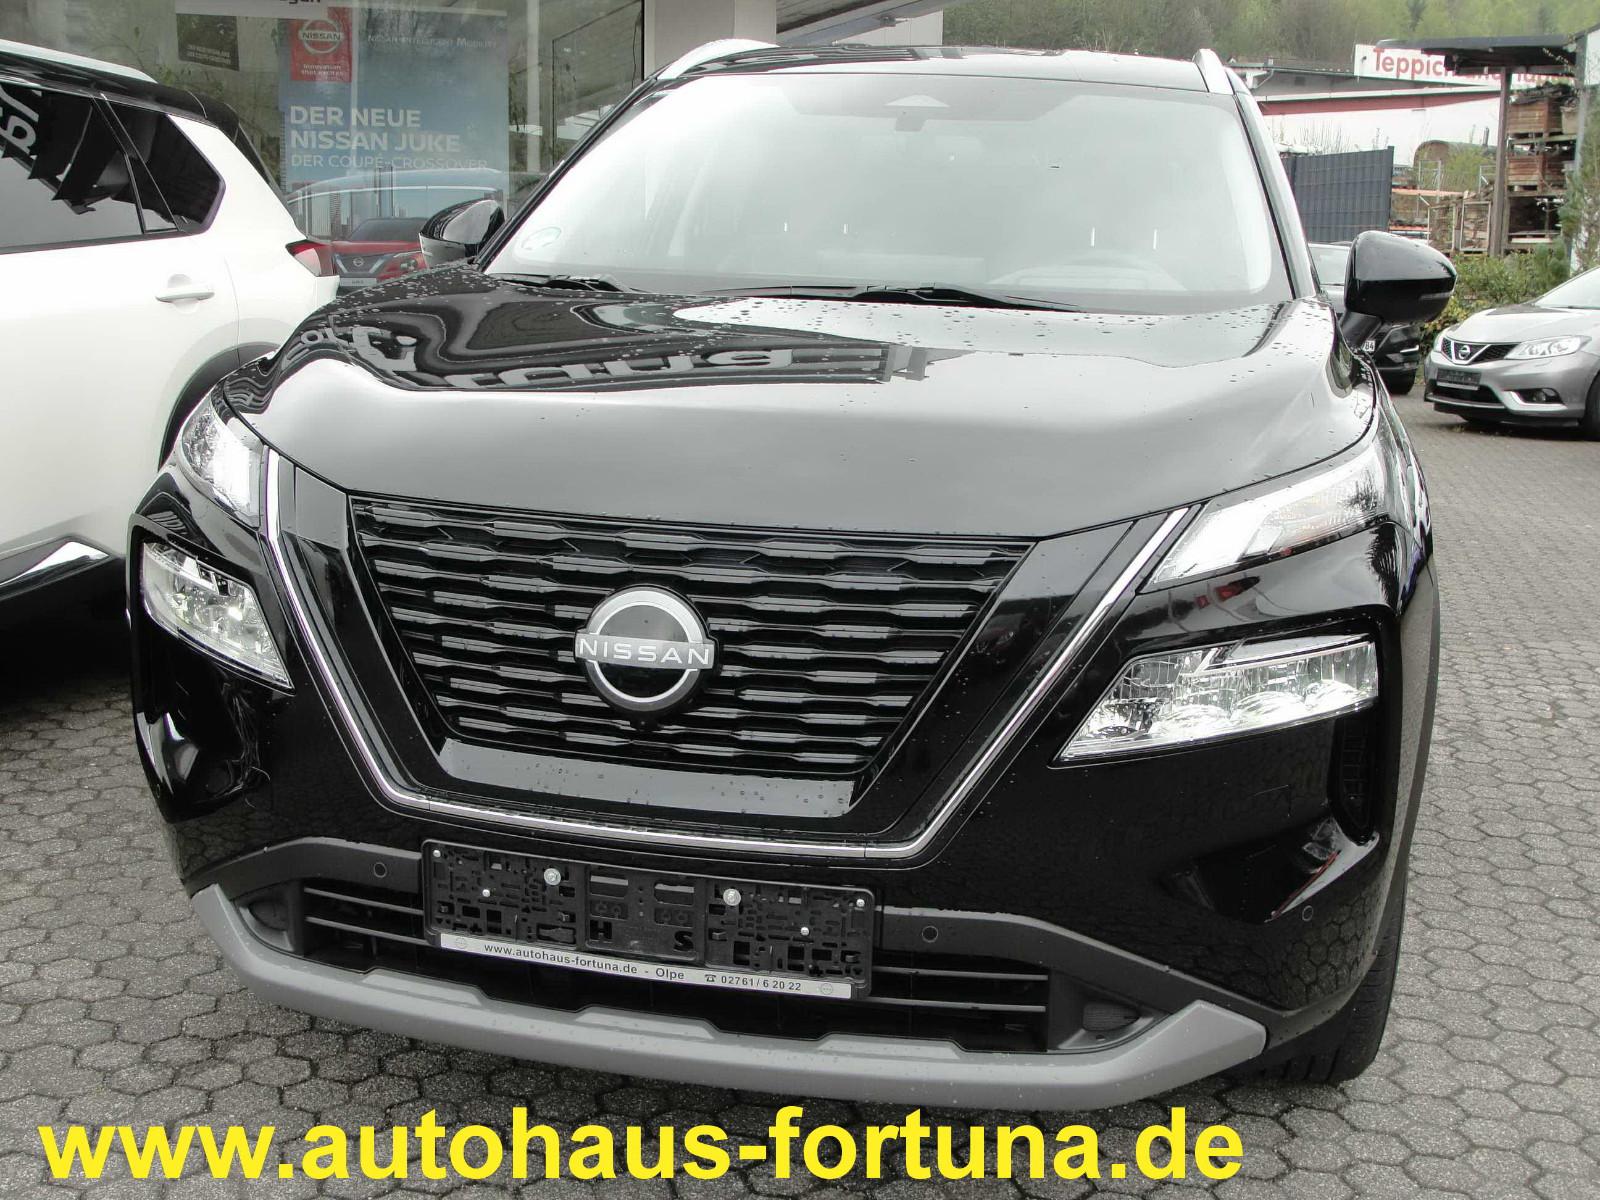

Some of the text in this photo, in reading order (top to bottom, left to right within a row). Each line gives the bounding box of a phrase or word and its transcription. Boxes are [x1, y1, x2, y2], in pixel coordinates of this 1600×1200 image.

[302, 31, 341, 41] NISSAN
[290, 105, 422, 128] DER NEUE
[290, 130, 462, 153] NISSAN JUKE
[291, 155, 324, 168] DER
[579, 638, 709, 665] NISSAN
[484, 943, 638, 974] www.autohaus-fortuna.de
[655, 967, 685, 981] Olpe
